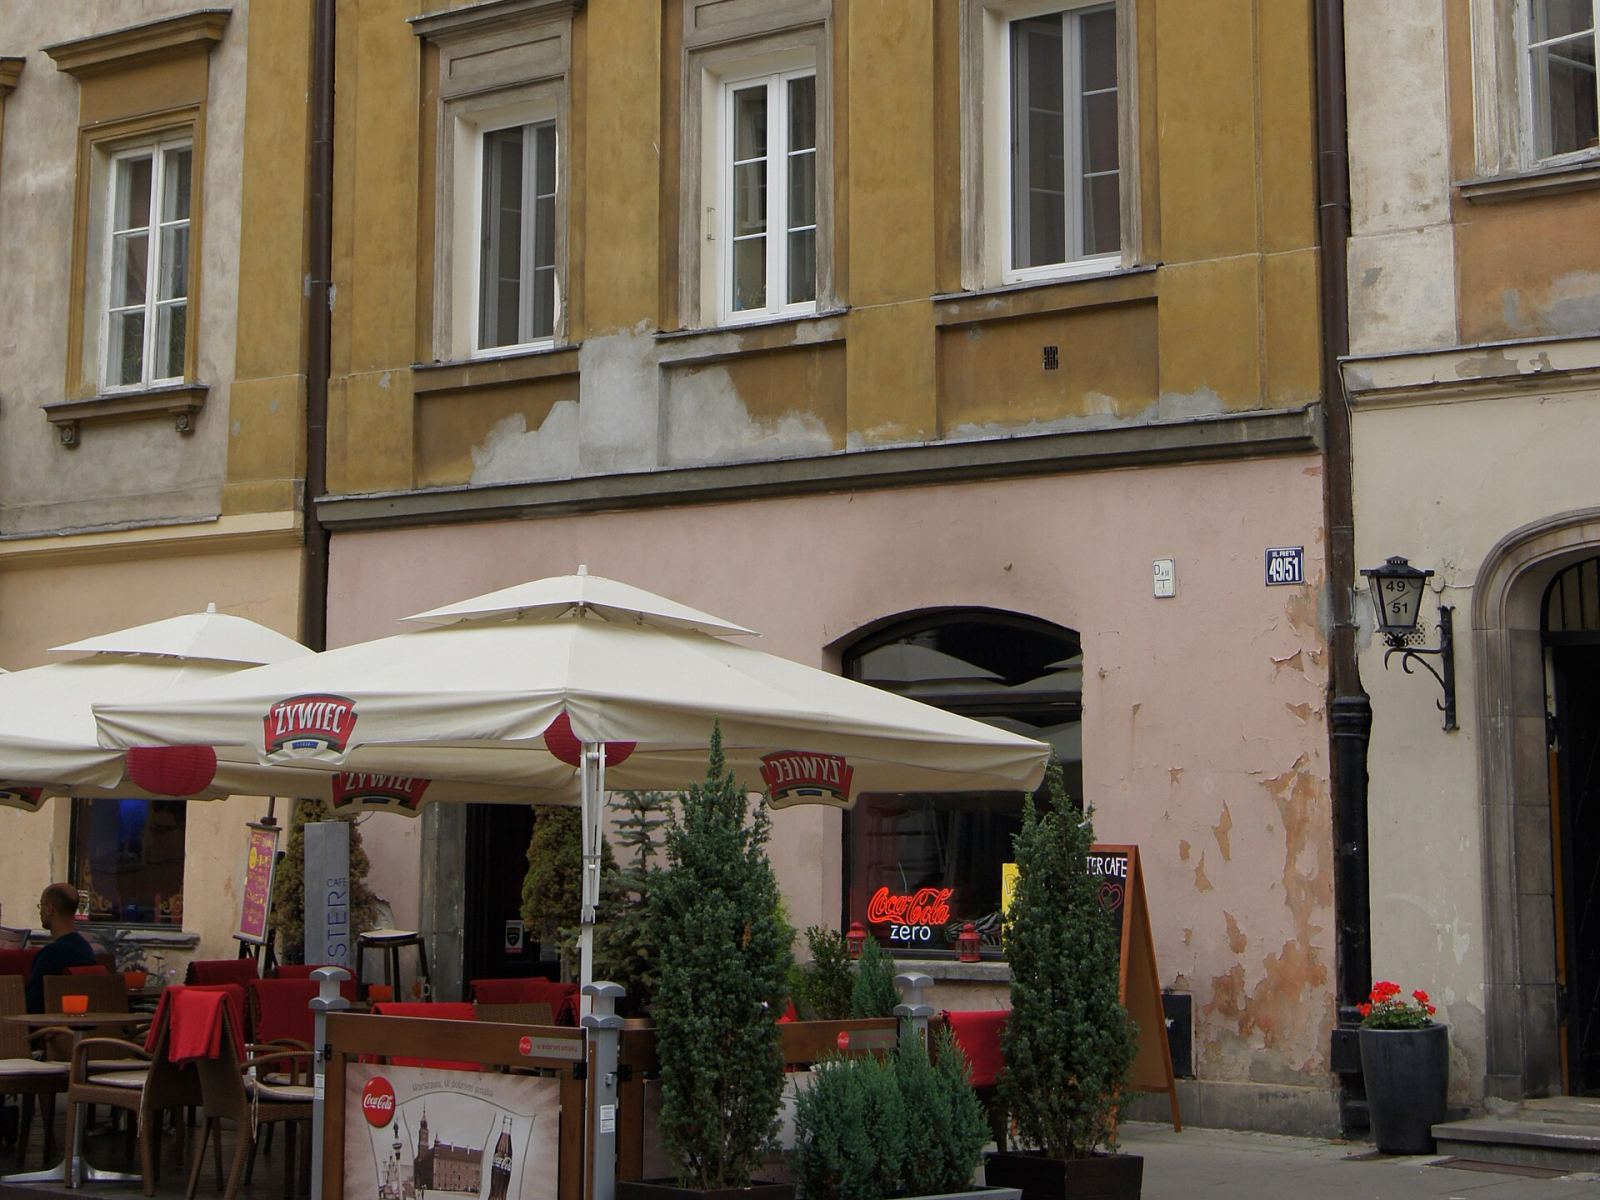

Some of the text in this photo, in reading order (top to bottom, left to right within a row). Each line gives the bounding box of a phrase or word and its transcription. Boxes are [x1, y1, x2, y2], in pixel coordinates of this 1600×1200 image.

[1268, 557, 1299, 582] 49/51
[1386, 580, 1405, 592] 49
[1392, 602, 1408, 614] 51
[275, 702, 347, 736] ŻYWIEC
[1104, 856, 1128, 878] CAFE
[890, 925, 931, 941] zero
